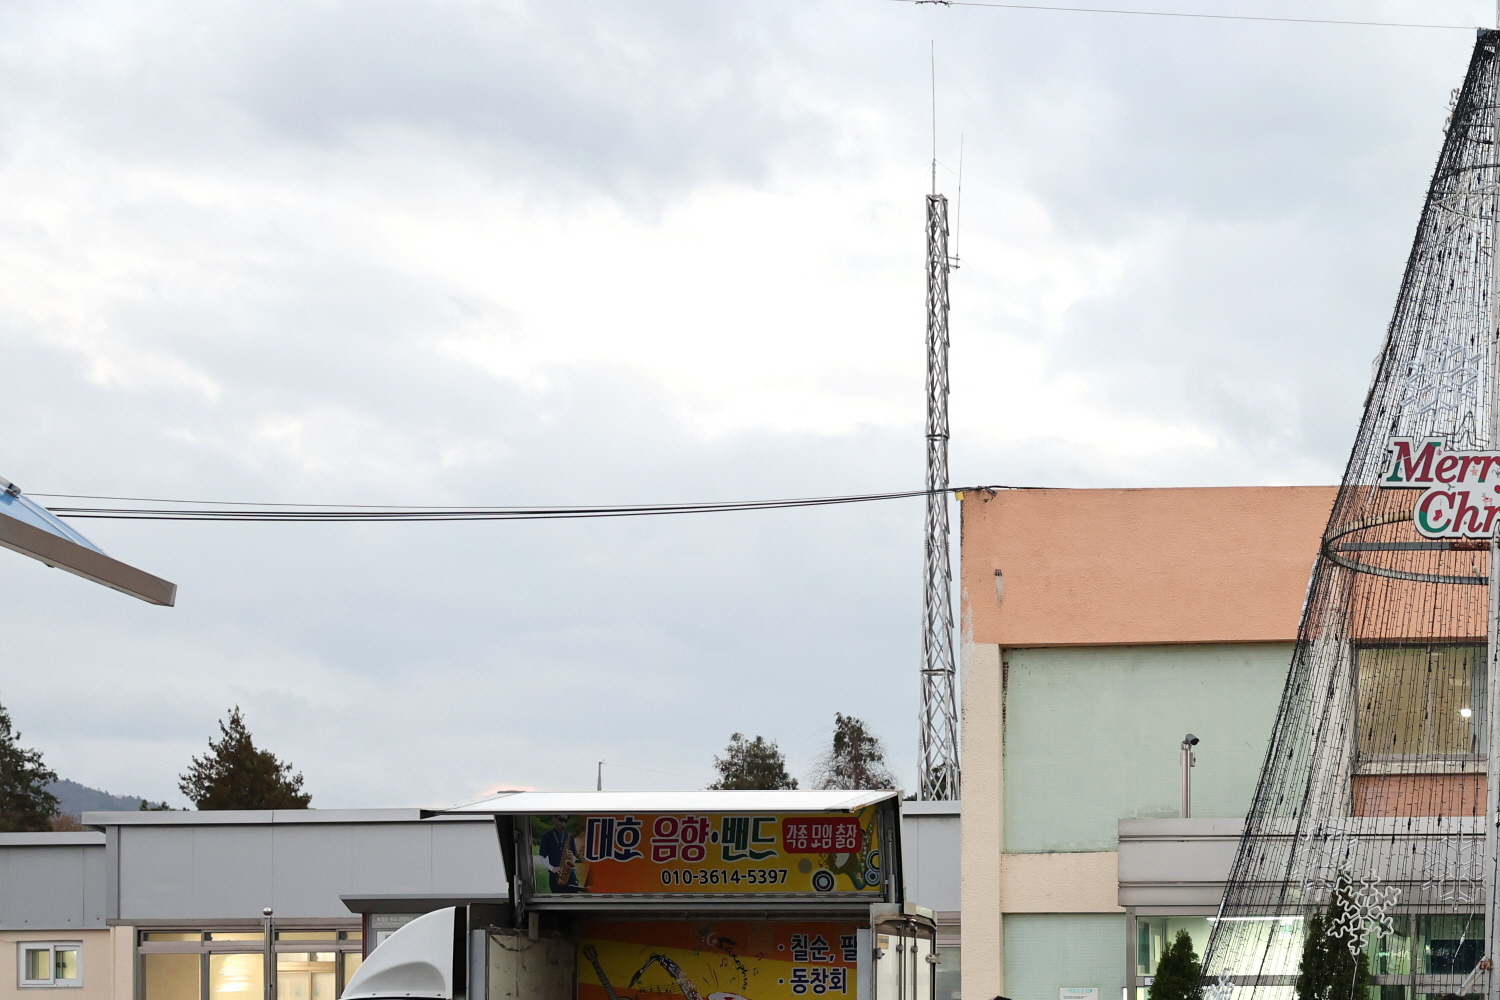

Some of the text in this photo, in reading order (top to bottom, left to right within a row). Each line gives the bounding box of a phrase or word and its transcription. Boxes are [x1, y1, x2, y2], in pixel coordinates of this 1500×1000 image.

[585, 816, 644, 862] 대호
[835, 823, 858, 849] 출장
[661, 868, 788, 885] 010-3614-5397
[790, 967, 848, 994] 동창회
